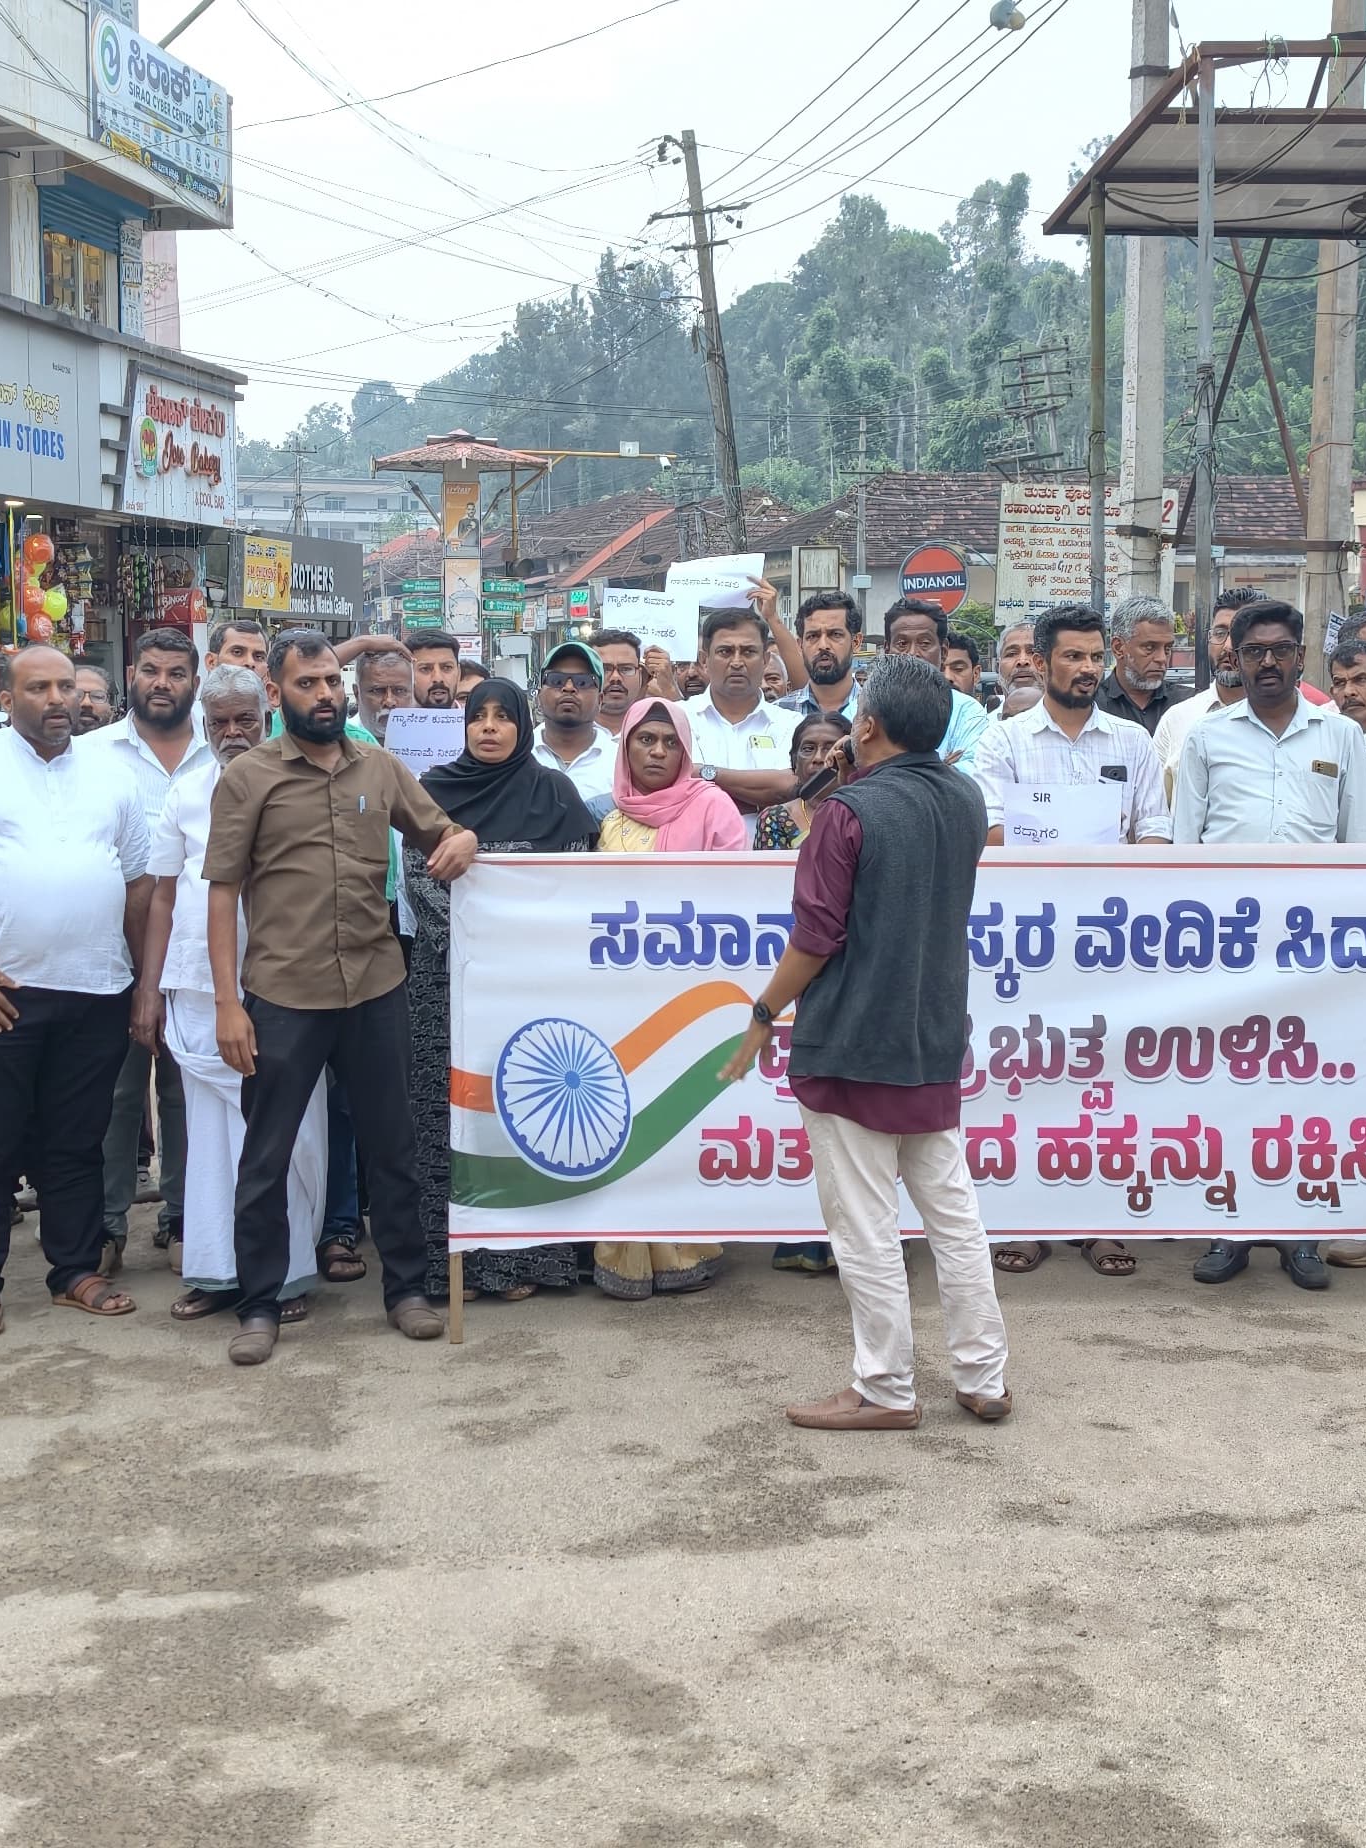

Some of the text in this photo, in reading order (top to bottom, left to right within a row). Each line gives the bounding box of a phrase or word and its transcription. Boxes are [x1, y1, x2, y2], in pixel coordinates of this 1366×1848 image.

[129, 82, 150, 106] SIRAQ
[153, 93, 171, 117] CYBER
[17, 423, 64, 461] STORES
[290, 562, 335, 593] ROTHERS
[903, 575, 965, 590] INDIANOIL
[334, 595, 354, 621] Gallery
[1033, 792, 1051, 803] SIR
[1014, 825, 1059, 843] ರದ್ದಾಗಲಿ
[1074, 897, 1260, 970] ವೇದಿಕೆ
[1124, 1014, 1356, 1080] ಉಳಿಸಿ..
[1037, 1114, 1237, 1213] ಹಕ್ಕನ್ನು
